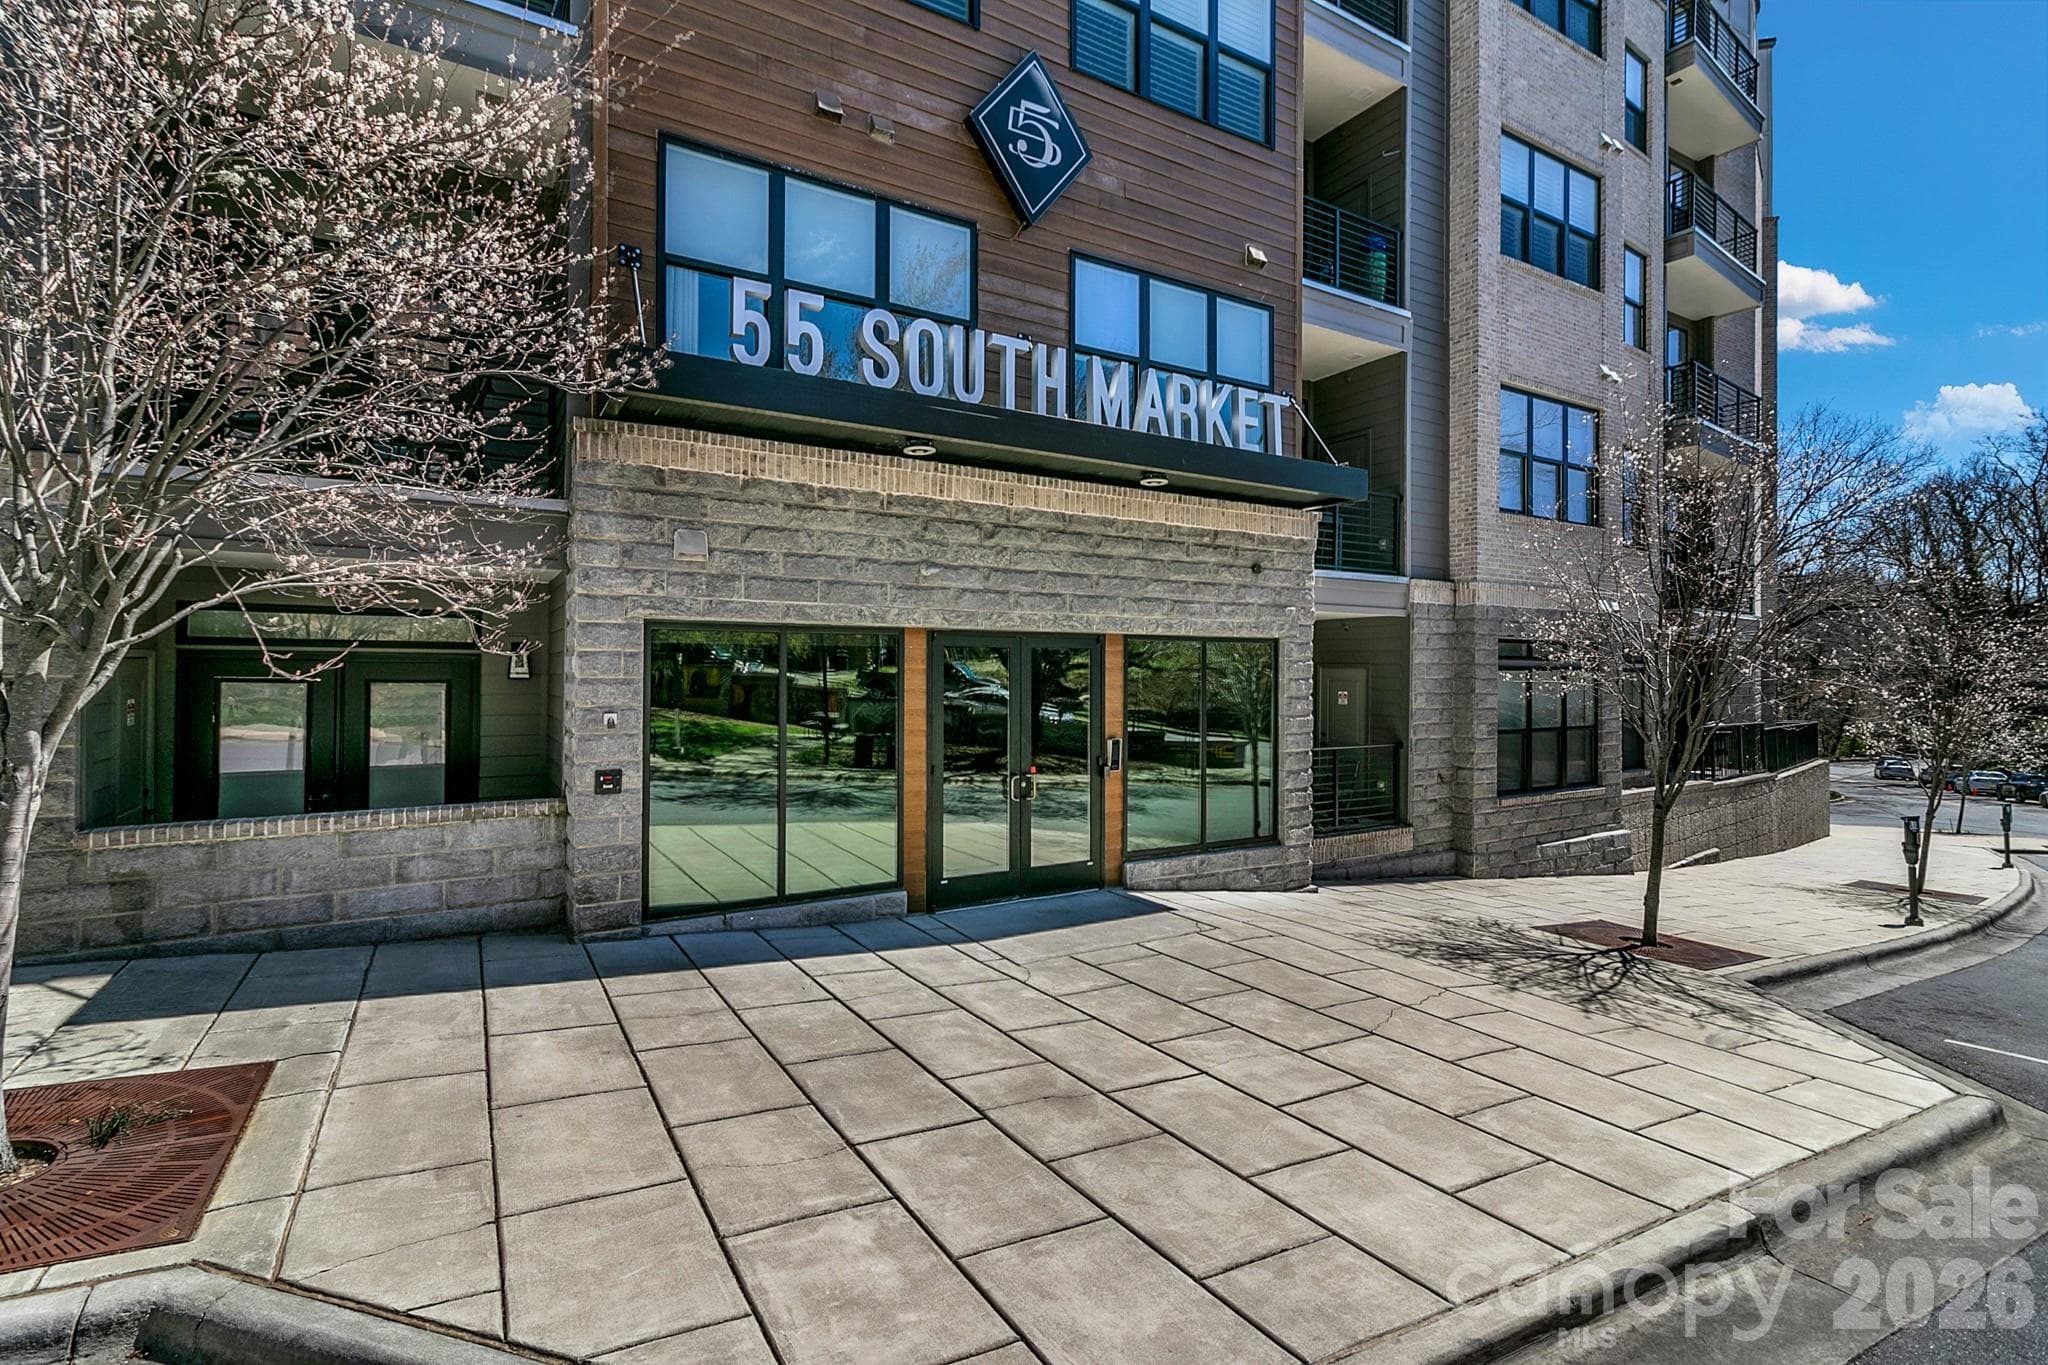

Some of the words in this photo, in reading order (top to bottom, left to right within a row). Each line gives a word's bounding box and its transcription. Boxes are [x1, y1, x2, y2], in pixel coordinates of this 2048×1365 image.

[731, 276, 825, 376] 55
[858, 308, 1067, 418] SOUTH
[1087, 355, 1292, 457] MARKET
